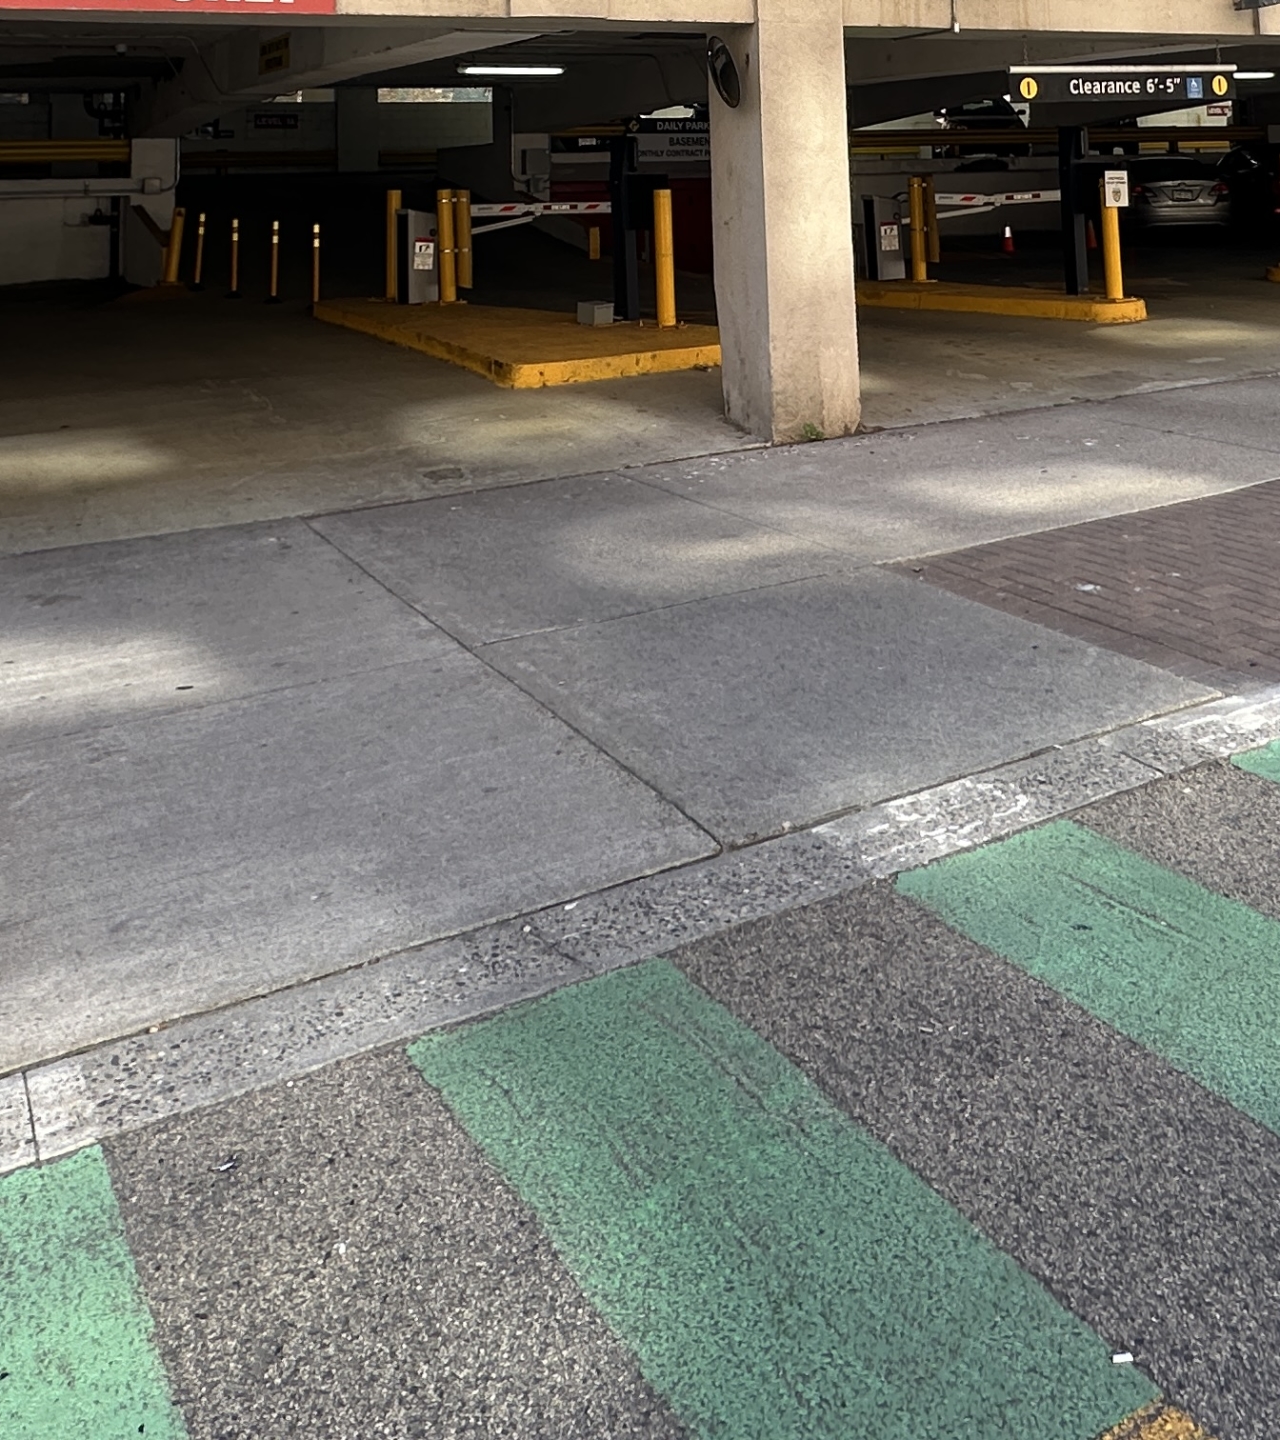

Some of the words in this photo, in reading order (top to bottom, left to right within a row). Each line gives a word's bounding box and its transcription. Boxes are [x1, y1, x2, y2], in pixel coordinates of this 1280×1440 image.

[1070, 78, 1141, 95] Clearance
[656, 121, 684, 131] DAILY
[685, 121, 710, 131] PARK
[669, 137, 710, 147] BASEMEN
[638, 149, 664, 158] ONTHLY
[665, 149, 704, 157] CONTRACT
